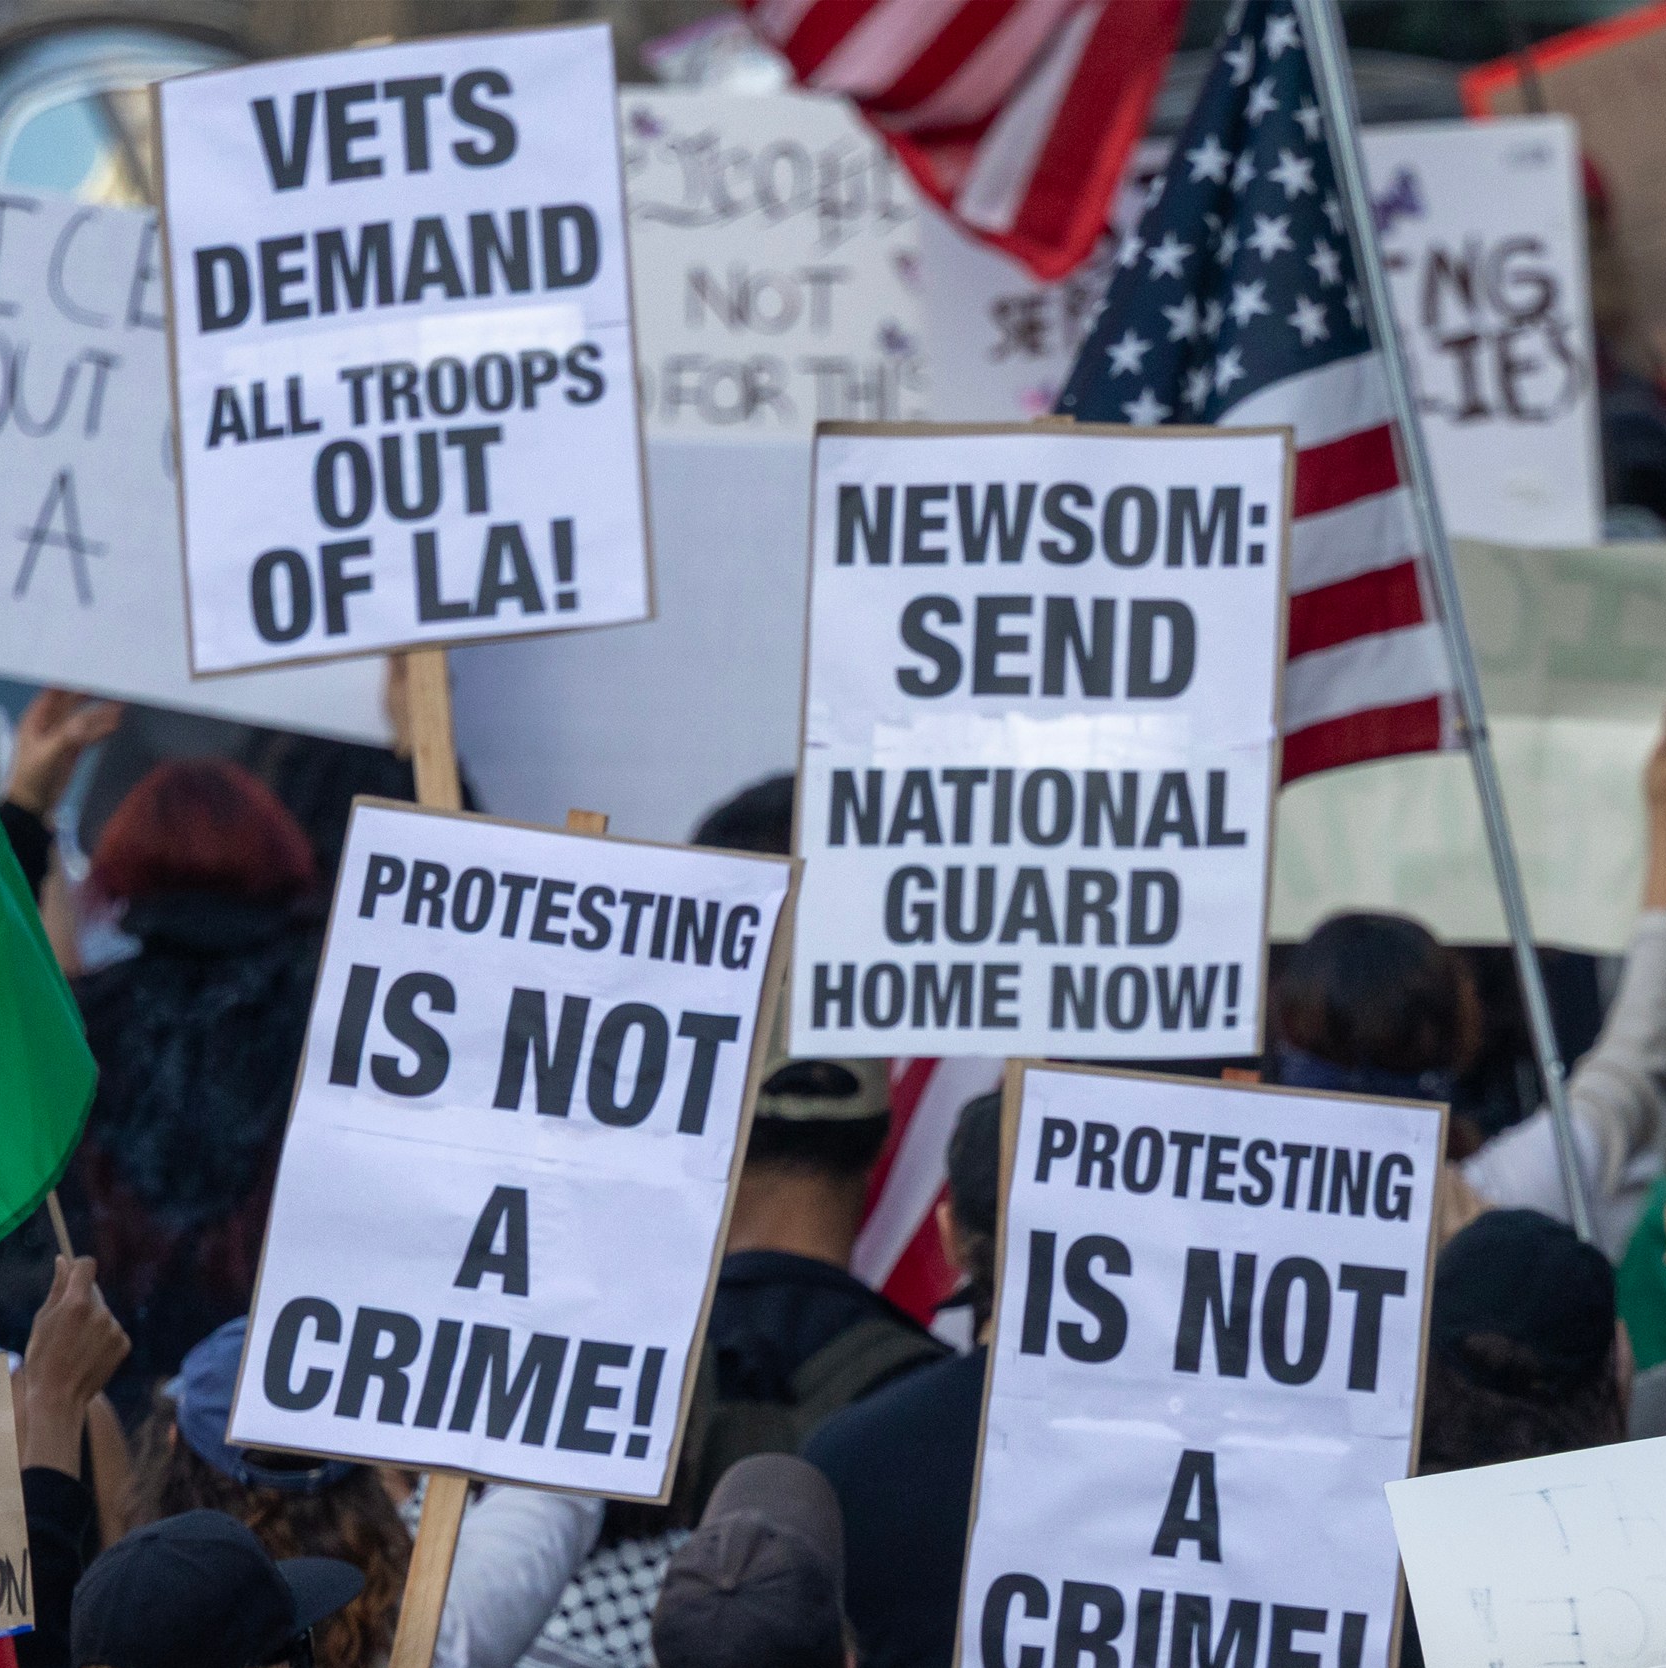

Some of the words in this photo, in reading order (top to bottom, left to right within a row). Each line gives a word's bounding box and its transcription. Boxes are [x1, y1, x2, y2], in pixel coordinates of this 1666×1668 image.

[252, 68, 516, 192] VETS
[194, 205, 602, 333] DEMAND
[684, 262, 852, 336] NOT
[205, 376, 321, 450] ALL
[340, 343, 606, 430] TROOPS
[659, 353, 797, 425] FOR
[312, 427, 503, 530] OUT
[835, 481, 1267, 569] NEWSOM:
[251, 542, 374, 647] OF
[411, 517, 581, 624] LA!
[895, 595, 1197, 700] SEND
[828, 767, 1247, 850] NATIONAL
[358, 851, 762, 973] PROTESTING
[884, 865, 1181, 947] GUARD
[811, 960, 1020, 1030] HOME
[1050, 964, 1240, 1031] NOW!
[328, 963, 457, 1100] IS
[495, 986, 740, 1138] NOT
[1034, 1115, 1415, 1223] PROTESTING
[453, 1184, 530, 1298] A
[1021, 1230, 1133, 1367] IS
[1174, 1247, 1407, 1394] NOT
[262, 1295, 666, 1460] CRIME!
[1150, 1448, 1224, 1564] A
